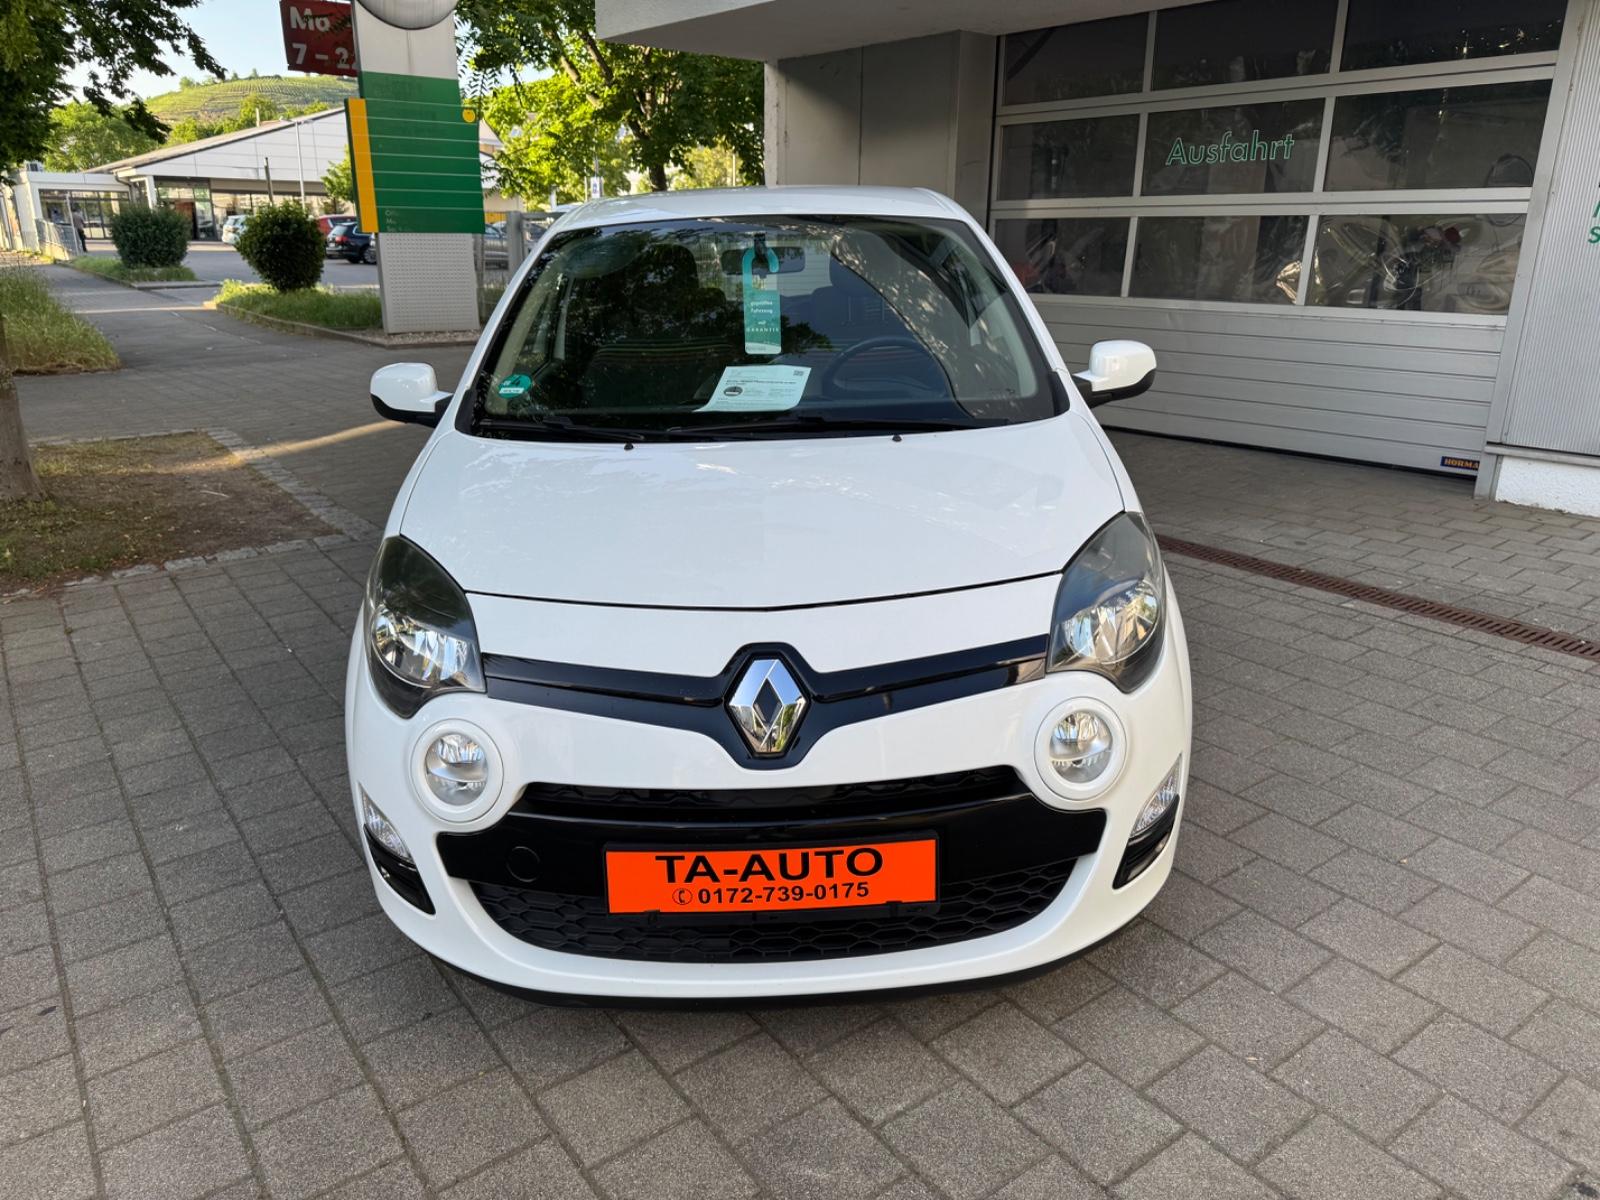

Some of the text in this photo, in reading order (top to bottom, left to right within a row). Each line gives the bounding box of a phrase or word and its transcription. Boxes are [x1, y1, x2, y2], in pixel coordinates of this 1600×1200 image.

[1165, 129, 1295, 165] Ausfahrt
[655, 848, 883, 883] TA-AUTO
[698, 882, 869, 905] 0172-739-0175
